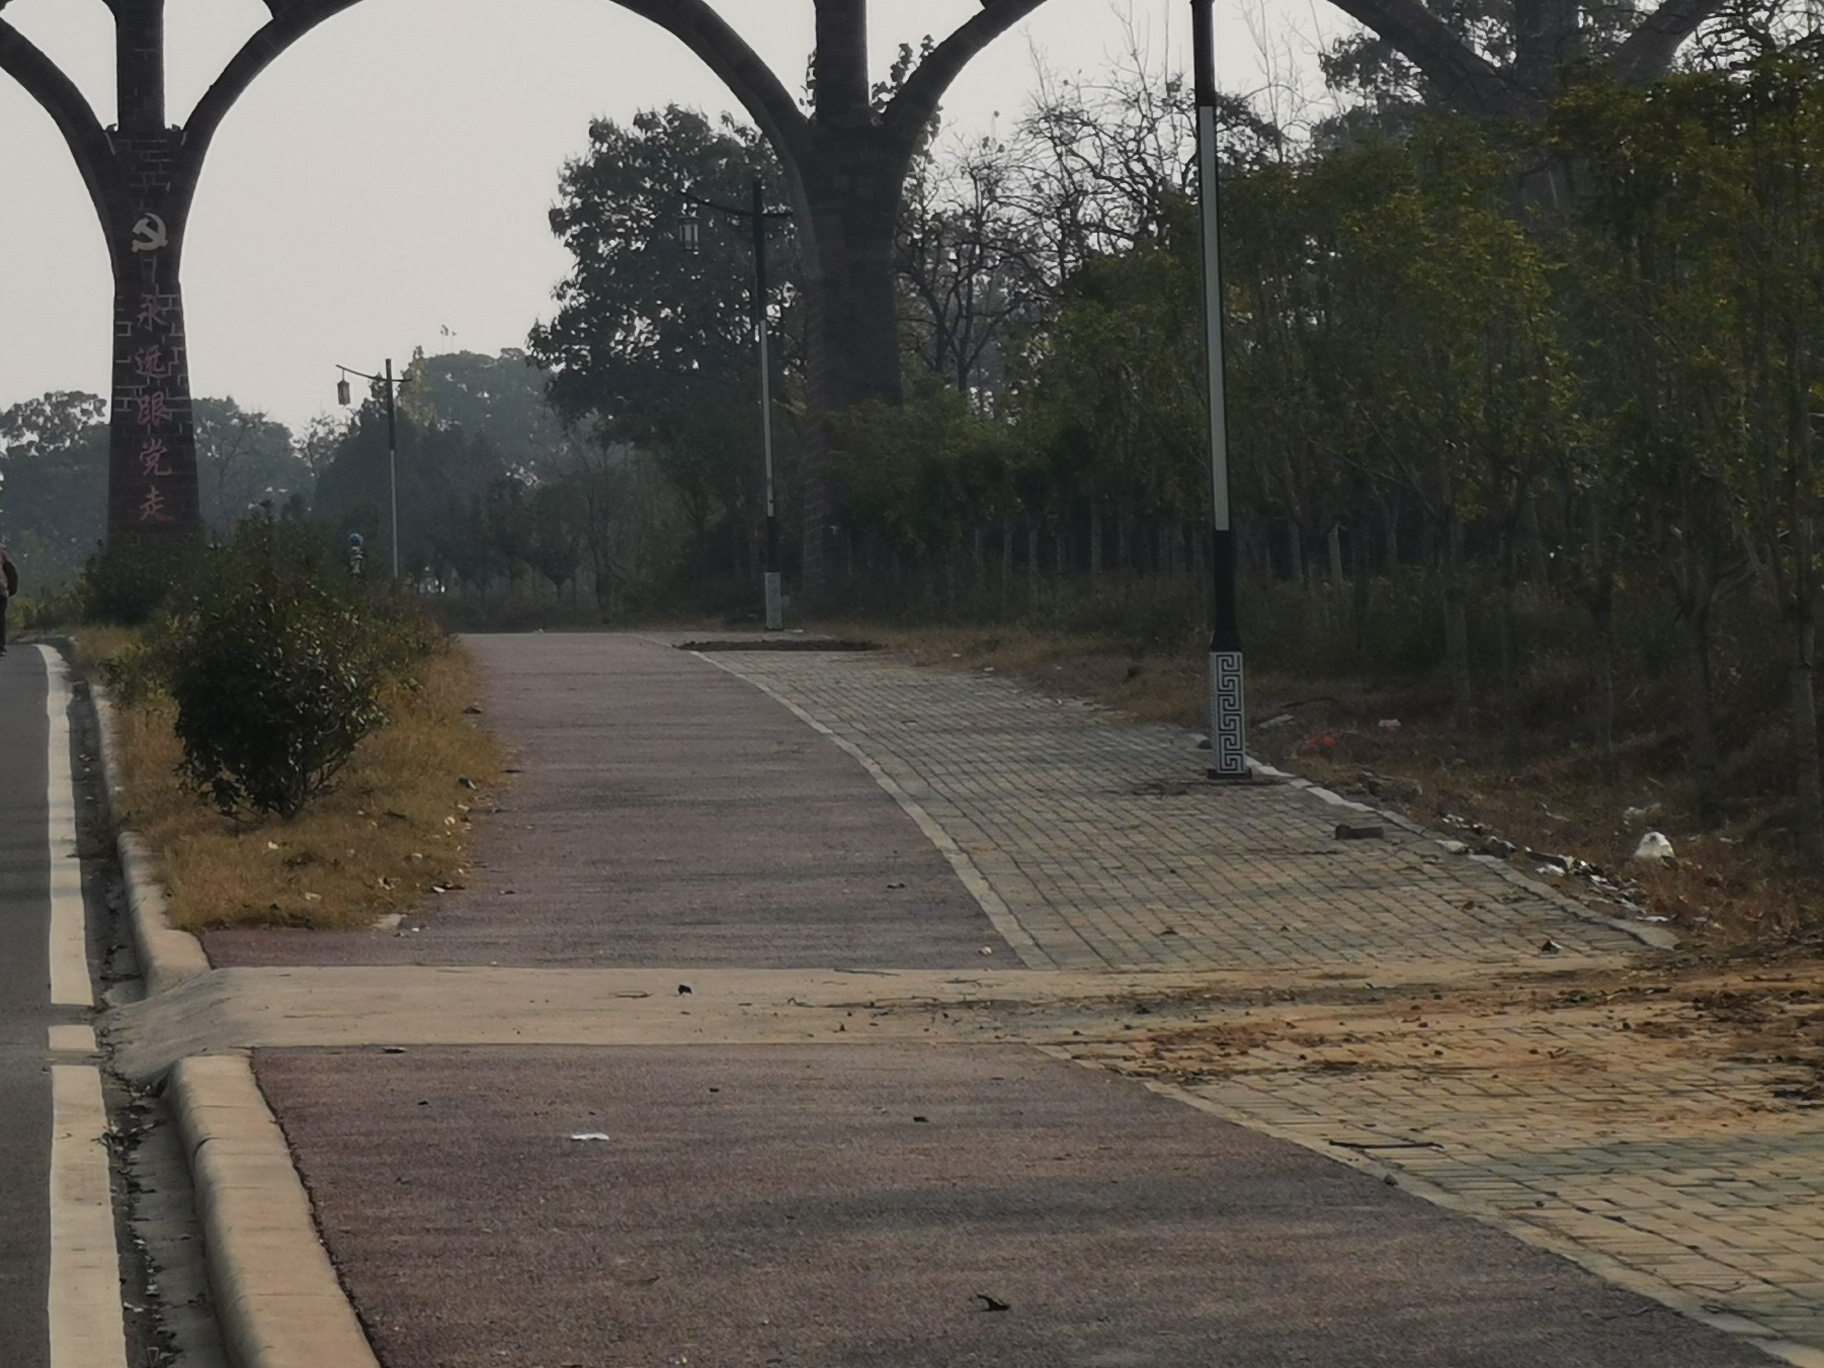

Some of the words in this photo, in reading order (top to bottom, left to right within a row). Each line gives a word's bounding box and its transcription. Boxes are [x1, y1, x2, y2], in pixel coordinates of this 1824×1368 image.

[134, 292, 175, 523] 永远跟党走
